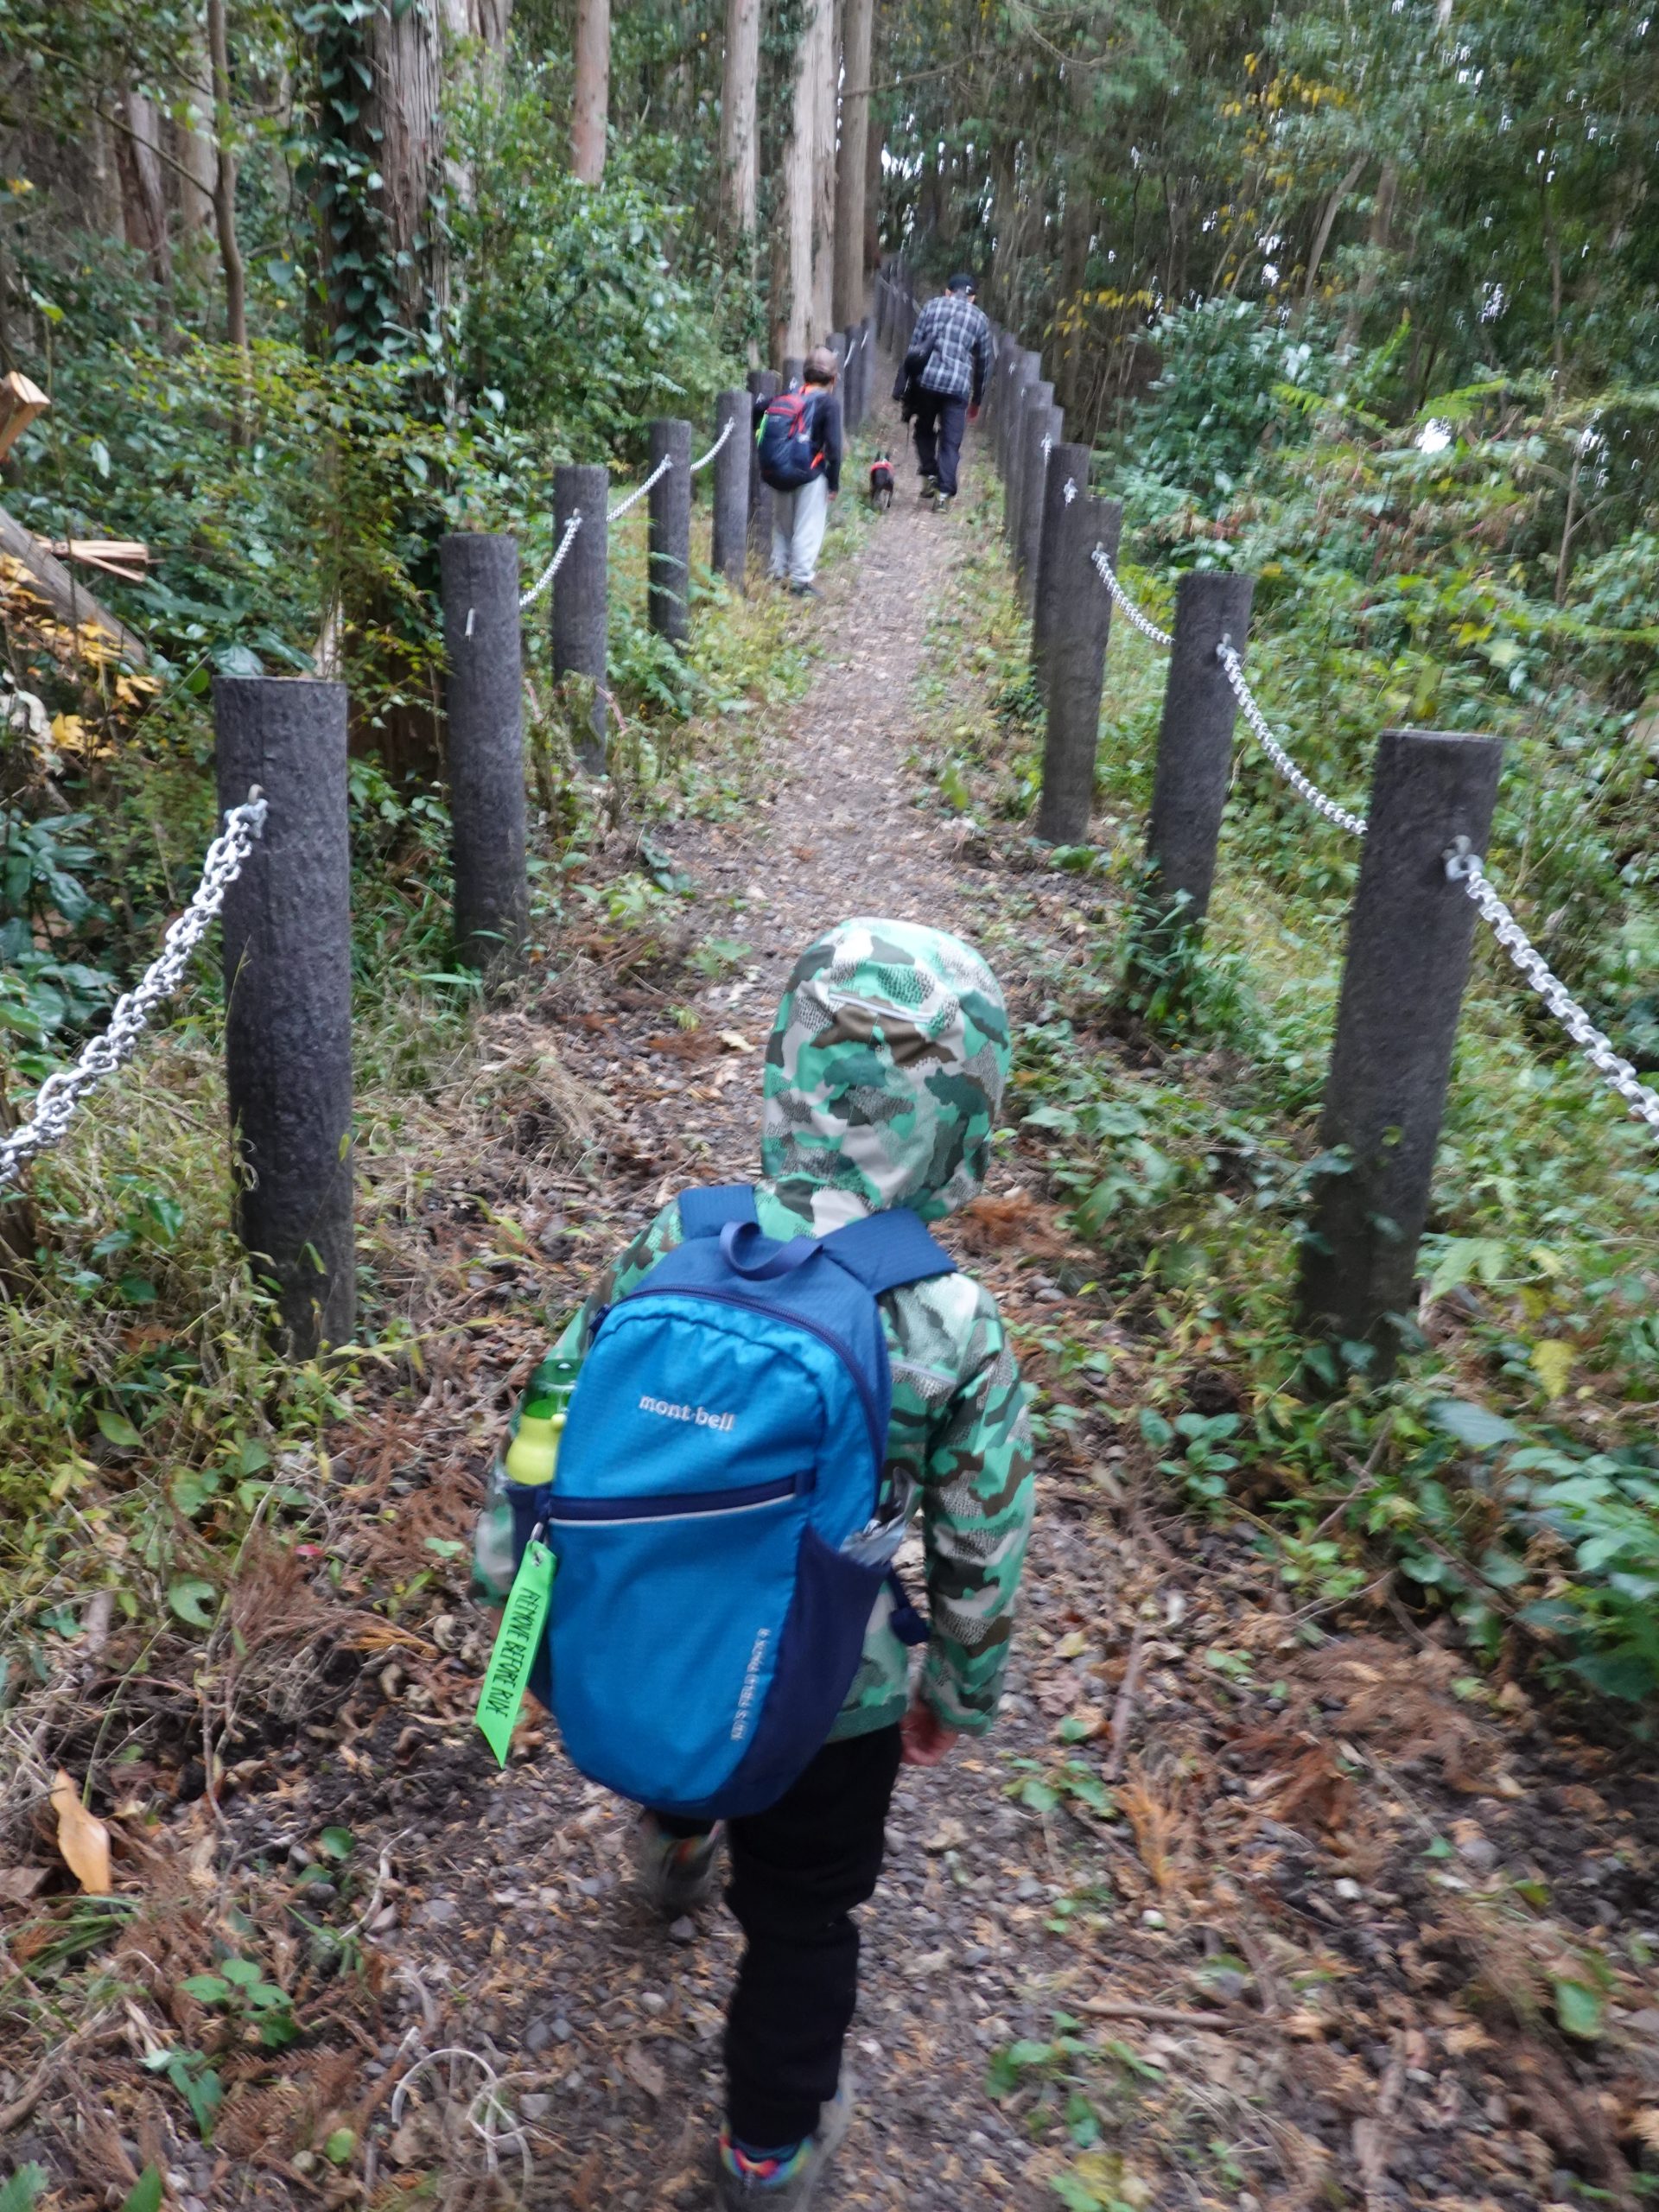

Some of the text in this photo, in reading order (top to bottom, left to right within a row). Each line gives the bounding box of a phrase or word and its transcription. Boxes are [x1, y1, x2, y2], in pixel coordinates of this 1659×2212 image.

[485, 1586, 542, 1719] REMOVE BEFORE RIDE
